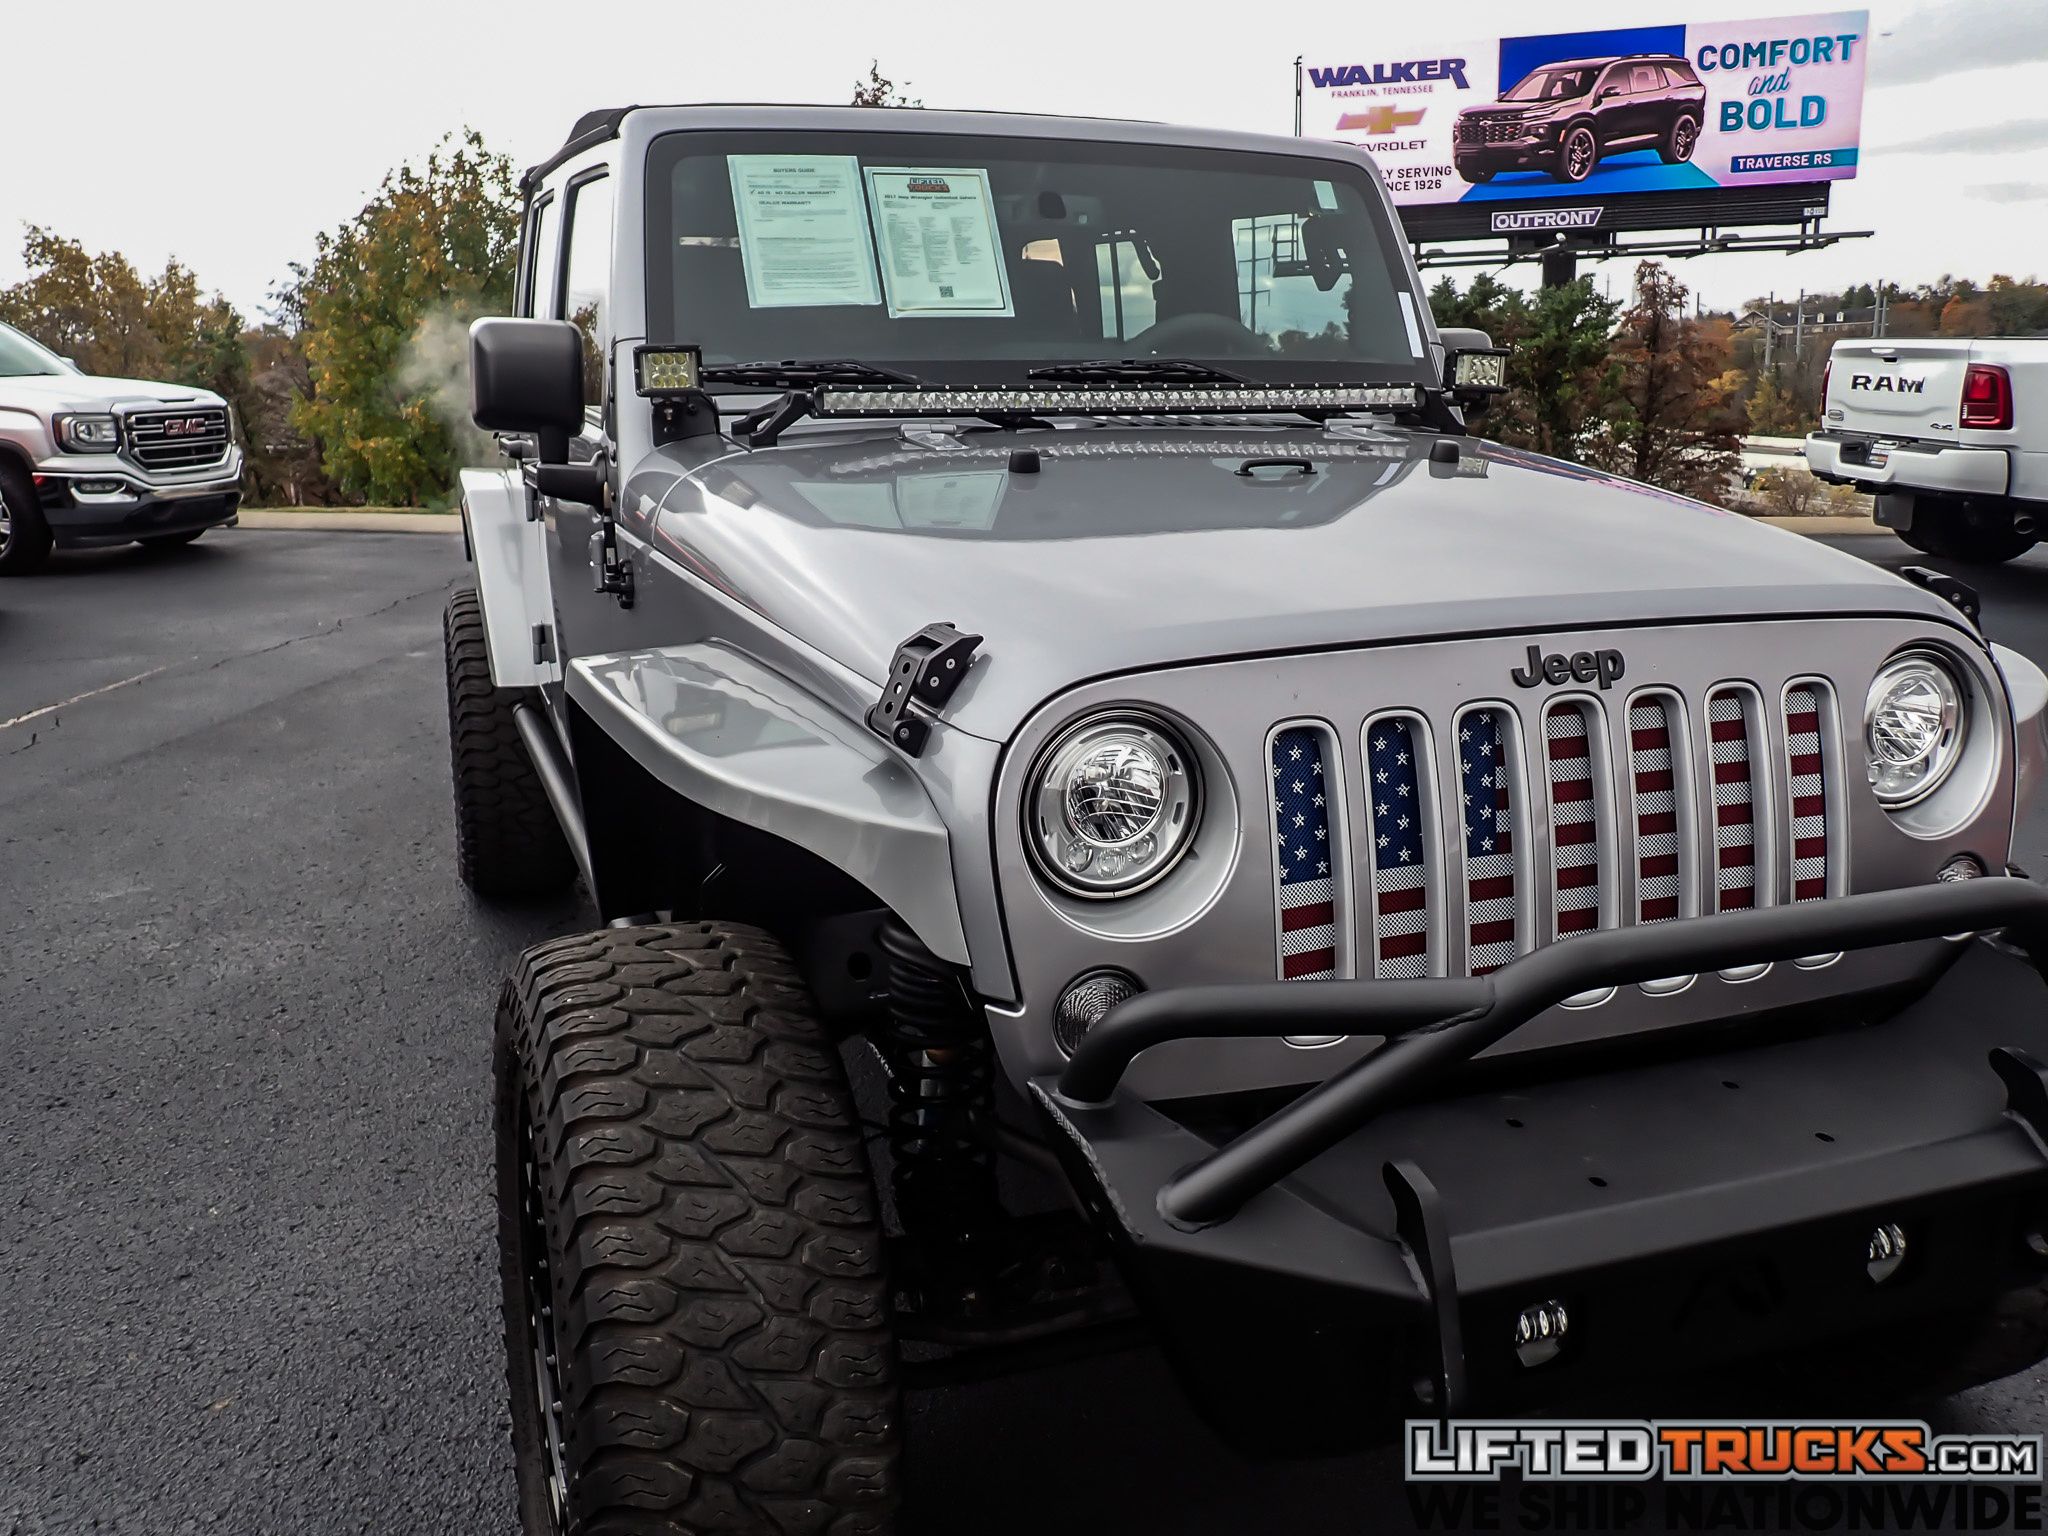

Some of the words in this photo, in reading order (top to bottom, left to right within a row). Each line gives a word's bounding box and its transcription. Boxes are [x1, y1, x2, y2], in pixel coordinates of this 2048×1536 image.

[1697, 34, 1858, 72] COMFORT
[1307, 58, 1471, 90] WALKER
[1747, 66, 1791, 96] and
[1331, 88, 1379, 99] FRANKLIN,
[1382, 84, 1434, 96] TENNESSEE
[1719, 95, 1827, 132] BOLD
[1356, 140, 1428, 152] VROLET
[1737, 155, 1810, 170] TRAVERSE
[1813, 153, 1832, 165] RS
[1397, 165, 1452, 179] SERVING
[1385, 181, 1411, 192] NCE
[1414, 179, 1442, 191] 1926
[1495, 210, 1596, 228] OUTFRONT
[1850, 375, 1926, 394] RAM
[165, 418, 206, 434] GMC
[1511, 645, 1626, 690] Jeep
